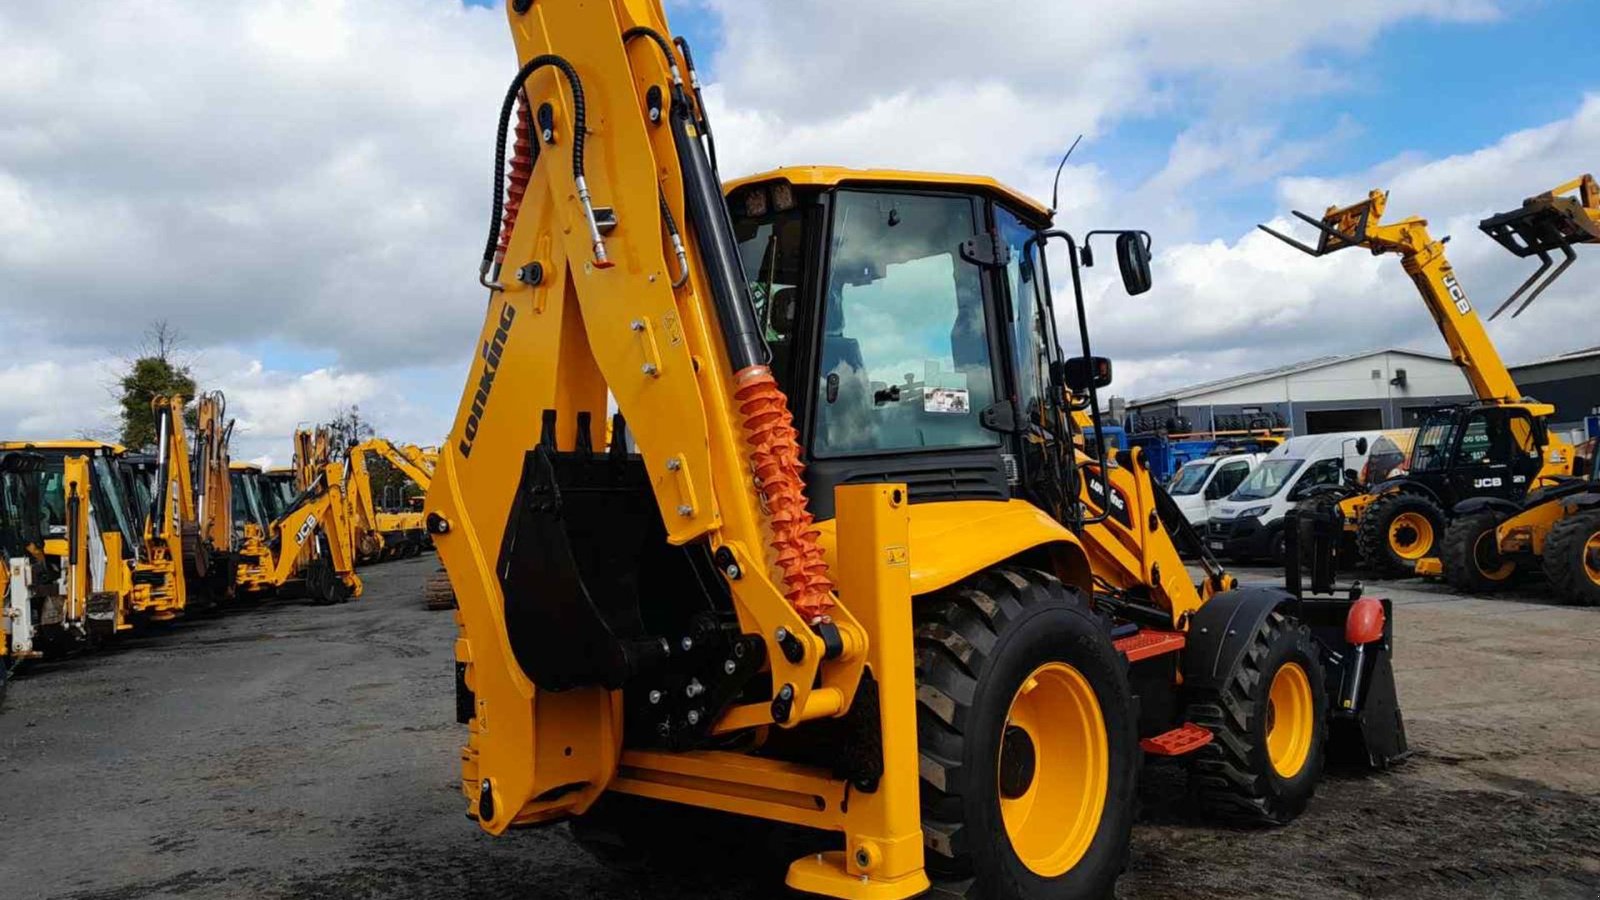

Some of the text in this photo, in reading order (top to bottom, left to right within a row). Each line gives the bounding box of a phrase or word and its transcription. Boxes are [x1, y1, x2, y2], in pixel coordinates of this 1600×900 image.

[1443, 276, 1470, 314] JCB
[1474, 477, 1502, 488] JCB
[296, 514, 316, 544] JCB
